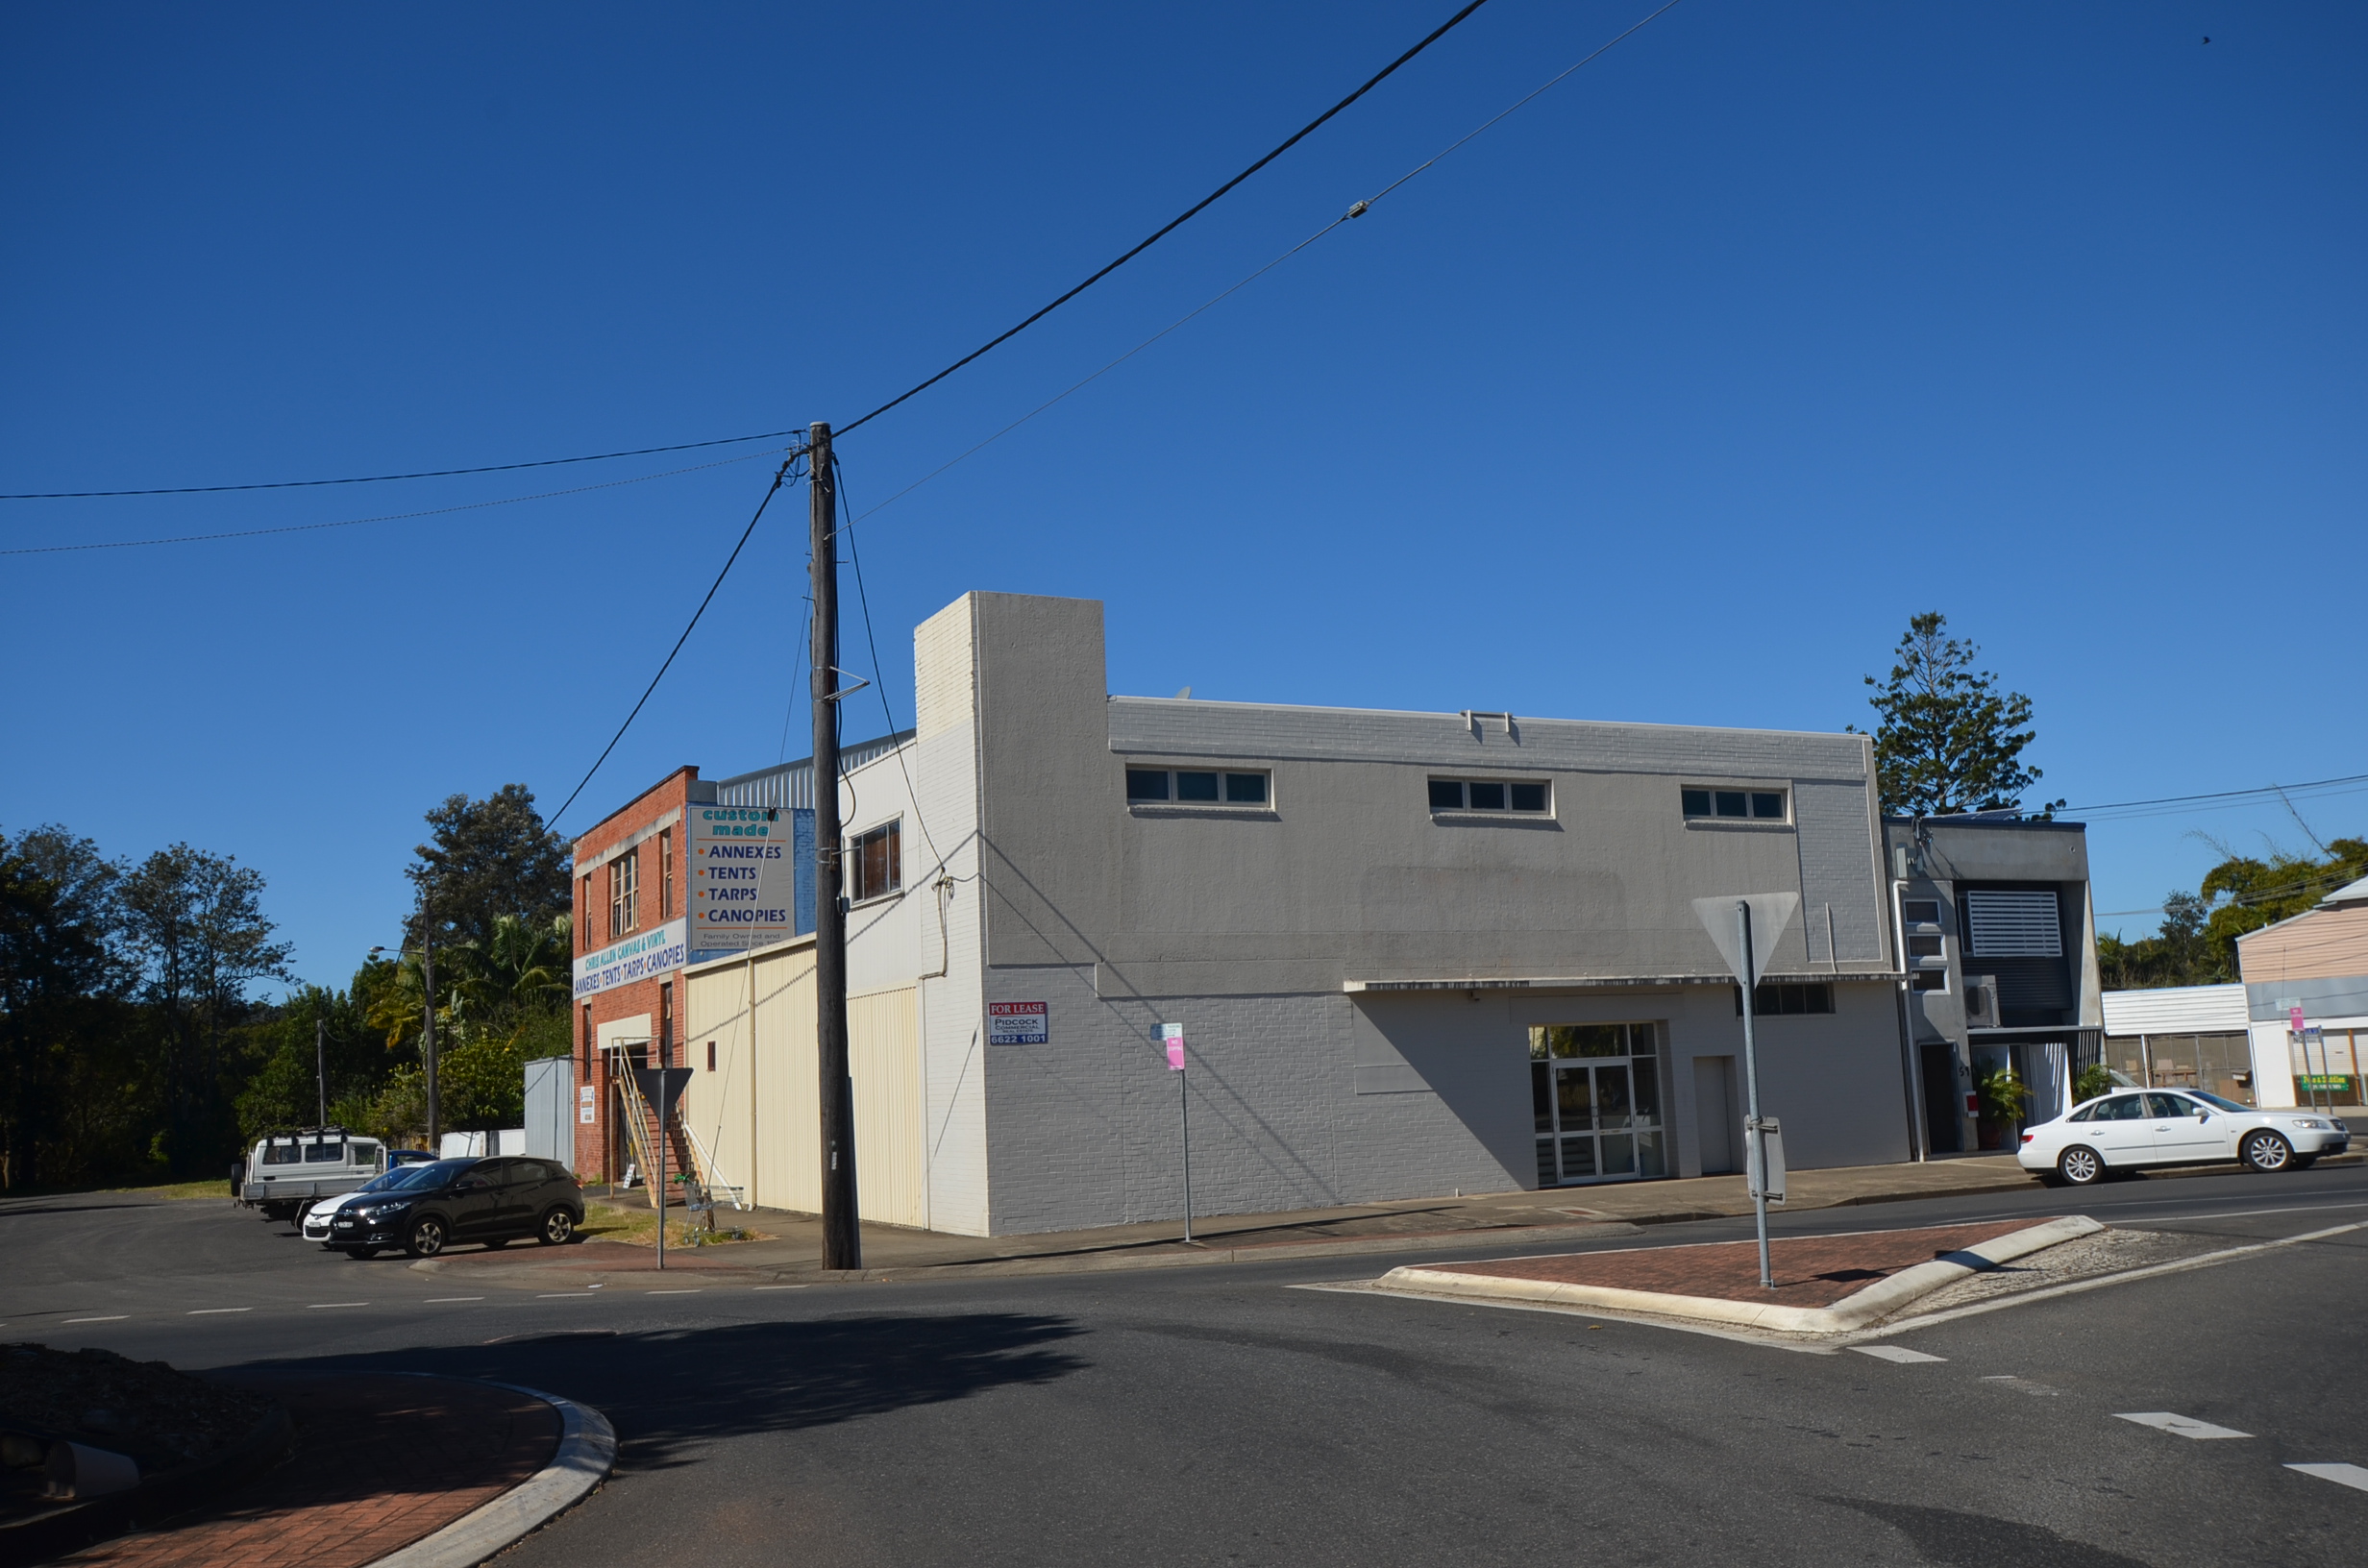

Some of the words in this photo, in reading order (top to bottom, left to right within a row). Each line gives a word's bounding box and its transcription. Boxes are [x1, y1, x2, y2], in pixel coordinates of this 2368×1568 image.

[712, 824, 769, 836] made
[709, 845, 781, 859] ANNEXES
[708, 867, 756, 880] TENTS
[708, 888, 757, 901] TARPS
[708, 909, 786, 922] CANOPIES
[585, 954, 600, 971] CHRIS
[600, 948, 617, 968] ALLEN
[618, 939, 641, 961] CANVAS
[641, 937, 647, 951] &
[647, 929, 666, 950] VINYL
[575, 972, 600, 995] ANNEXES
[602, 965, 621, 987] TENTS
[623, 957, 644, 980] TARPS
[647, 943, 684, 972] CANOPIES
[991, 1004, 1012, 1015] FOR
[1013, 1003, 1045, 1014] LEASE
[991, 1035, 1018, 1043] 6622
[1021, 1034, 1046, 1042] 1001
